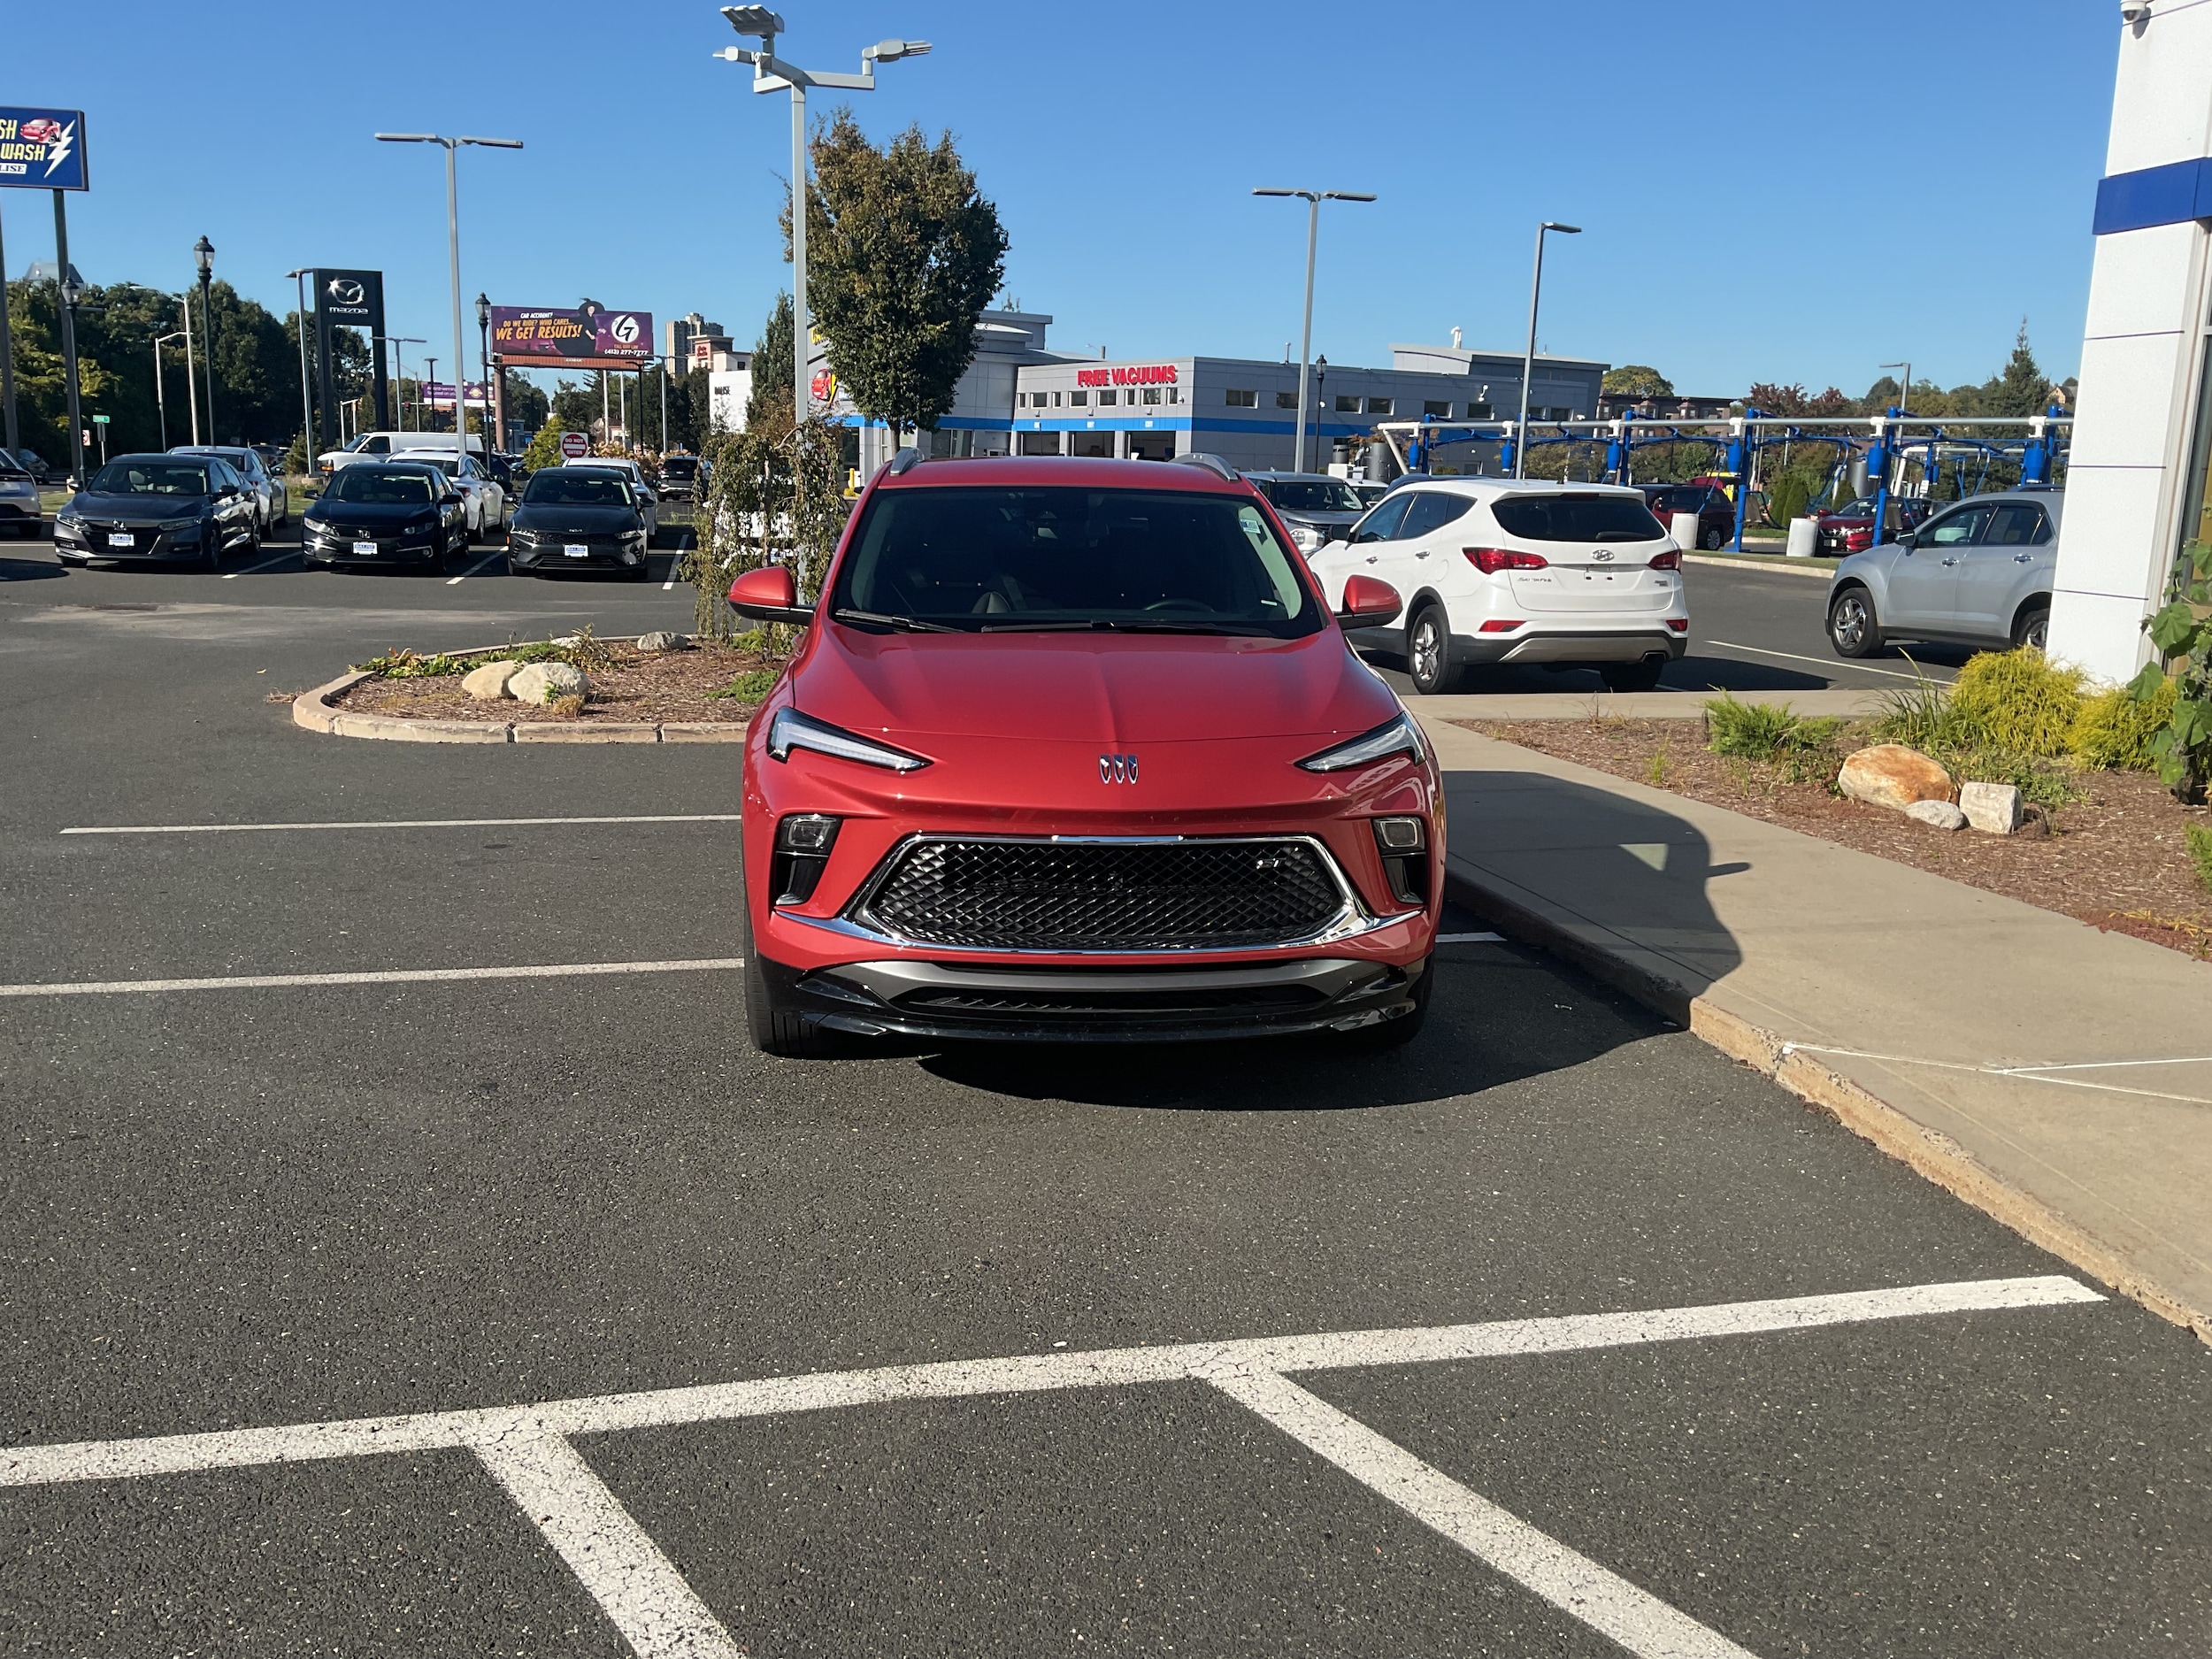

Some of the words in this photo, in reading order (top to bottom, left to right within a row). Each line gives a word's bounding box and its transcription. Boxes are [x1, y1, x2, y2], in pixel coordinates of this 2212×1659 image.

[1, 143, 45, 161] WASH
[495, 327, 512, 340] WE
[516, 326, 535, 340] GET
[537, 324, 583, 339] RESULTS!
[1078, 369, 1110, 386] FREE
[1111, 365, 1178, 384] VACUUMS
